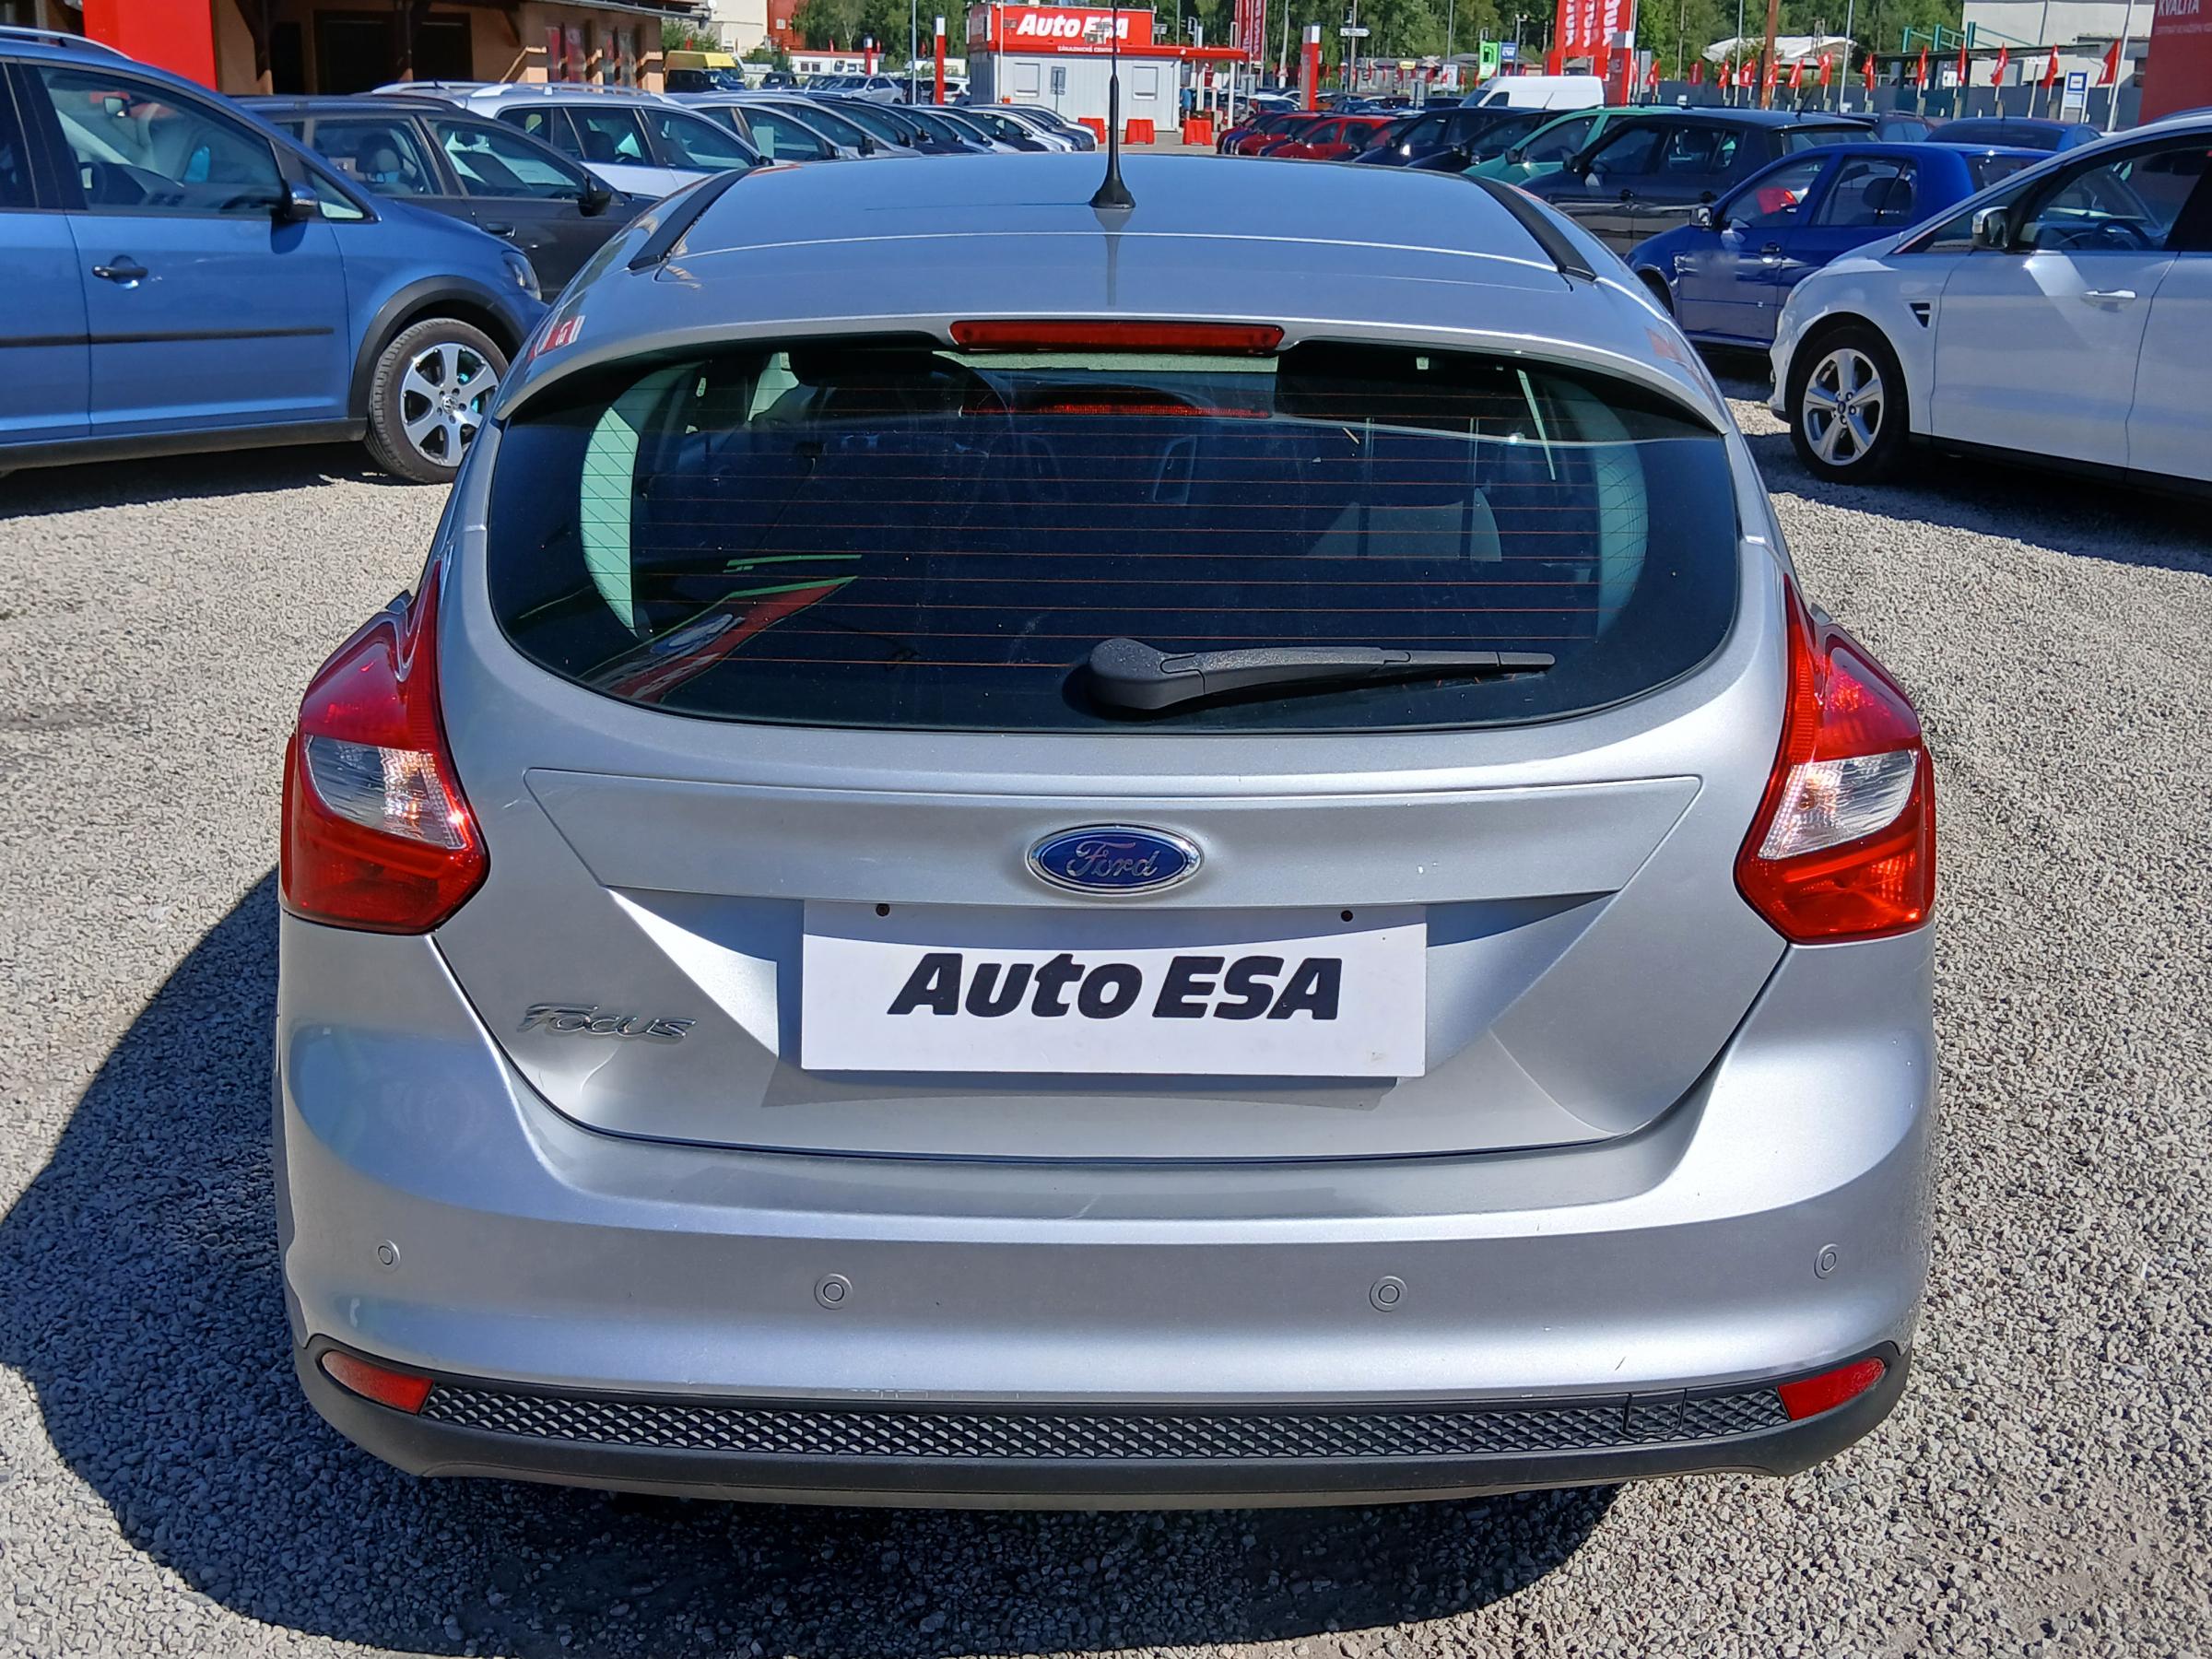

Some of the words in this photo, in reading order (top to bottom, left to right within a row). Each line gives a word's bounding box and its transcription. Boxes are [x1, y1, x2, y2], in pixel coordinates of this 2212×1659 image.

[1017, 14, 1081, 38] Auto
[1065, 840, 1161, 877] Ford
[887, 952, 1144, 1019] Auto
[1151, 955, 1343, 1020] ESA
